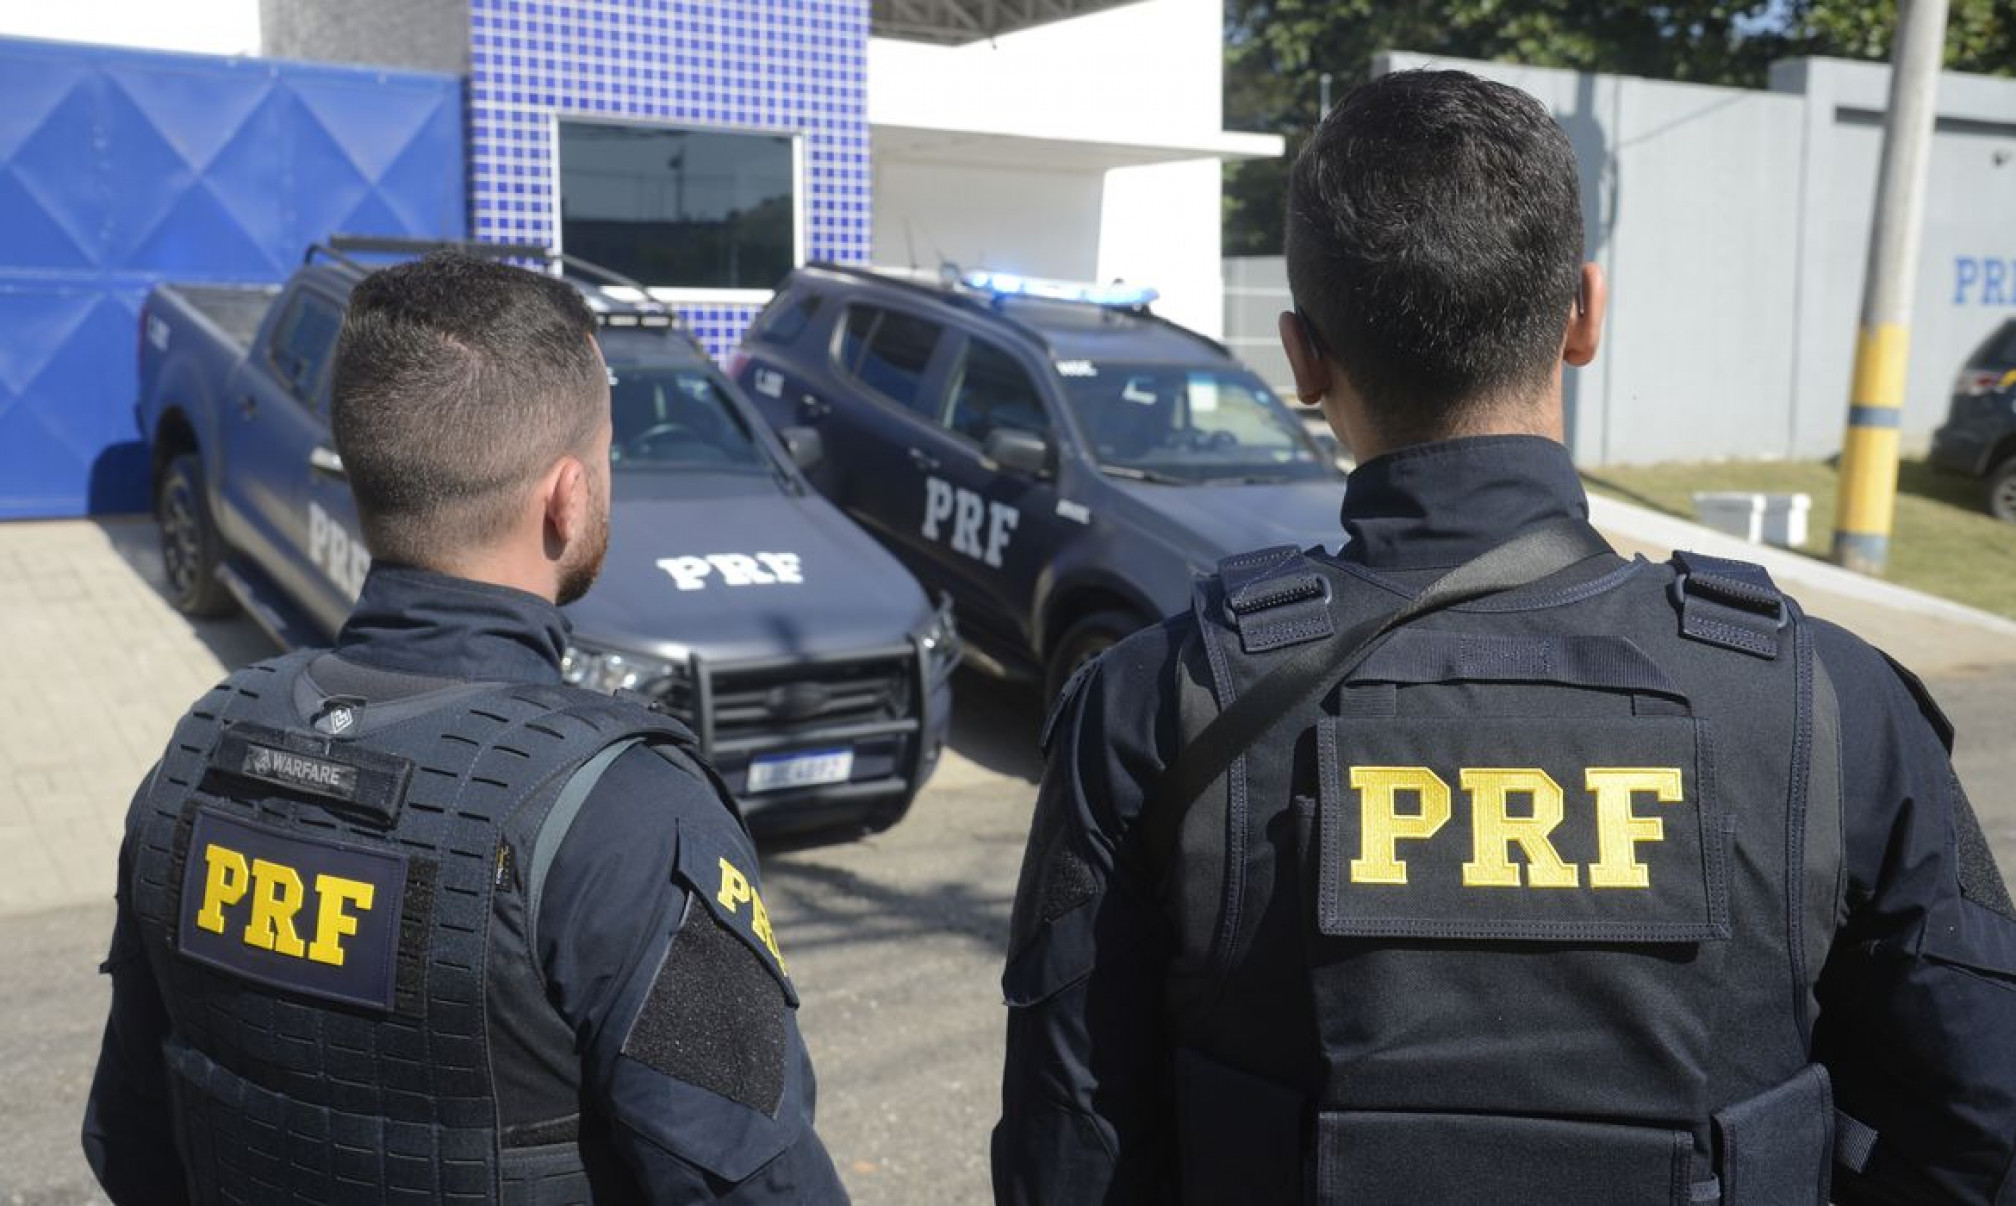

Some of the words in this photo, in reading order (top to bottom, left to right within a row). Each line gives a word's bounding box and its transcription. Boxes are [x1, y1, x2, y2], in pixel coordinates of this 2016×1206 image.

[1954, 256, 2016, 305] PR
[921, 477, 1020, 568] PRF
[656, 552, 803, 591] PRF
[273, 751, 340, 785] WARFARE
[1349, 766, 1684, 888] PRF
[197, 843, 375, 966] PRF
[717, 857, 788, 977] PR
